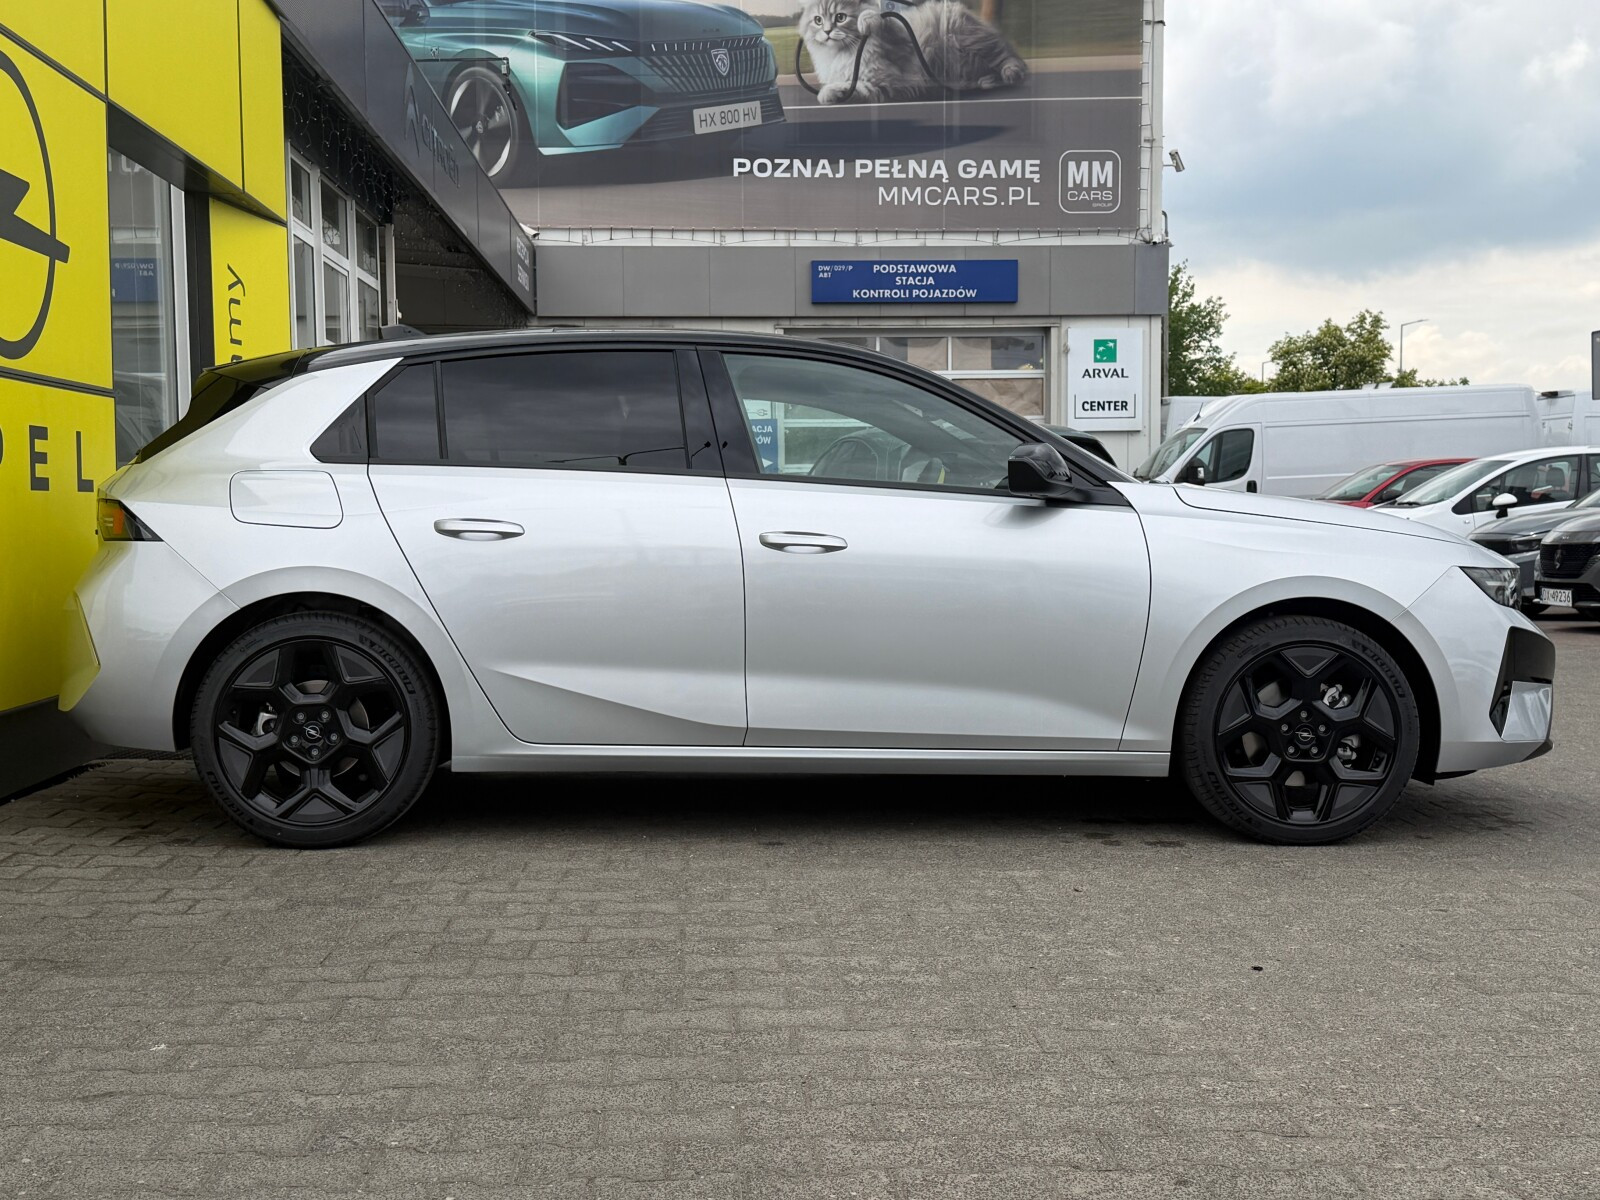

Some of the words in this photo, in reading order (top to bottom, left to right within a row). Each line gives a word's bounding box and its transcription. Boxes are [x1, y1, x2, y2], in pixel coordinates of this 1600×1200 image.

[699, 112, 717, 128] HX
[720, 109, 740, 125] 800
[743, 107, 757, 121] HV
[733, 158, 845, 178] POZNAJ
[855, 159, 949, 183] PEŁNĄ
[957, 159, 1040, 183] GAMĘ
[1067, 160, 1113, 188] MM
[878, 186, 1040, 206] MMCARS.PL
[1067, 190, 1113, 201] CARS
[873, 264, 957, 273] PODSTAWOWA
[895, 276, 935, 285] STACJA
[852, 289, 909, 298] KONTROLI
[912, 286, 978, 298] POJAZDÓW
[1082, 368, 1129, 378] ARVAL
[1081, 401, 1128, 411] CENTER
[0, 424, 94, 493] EL
